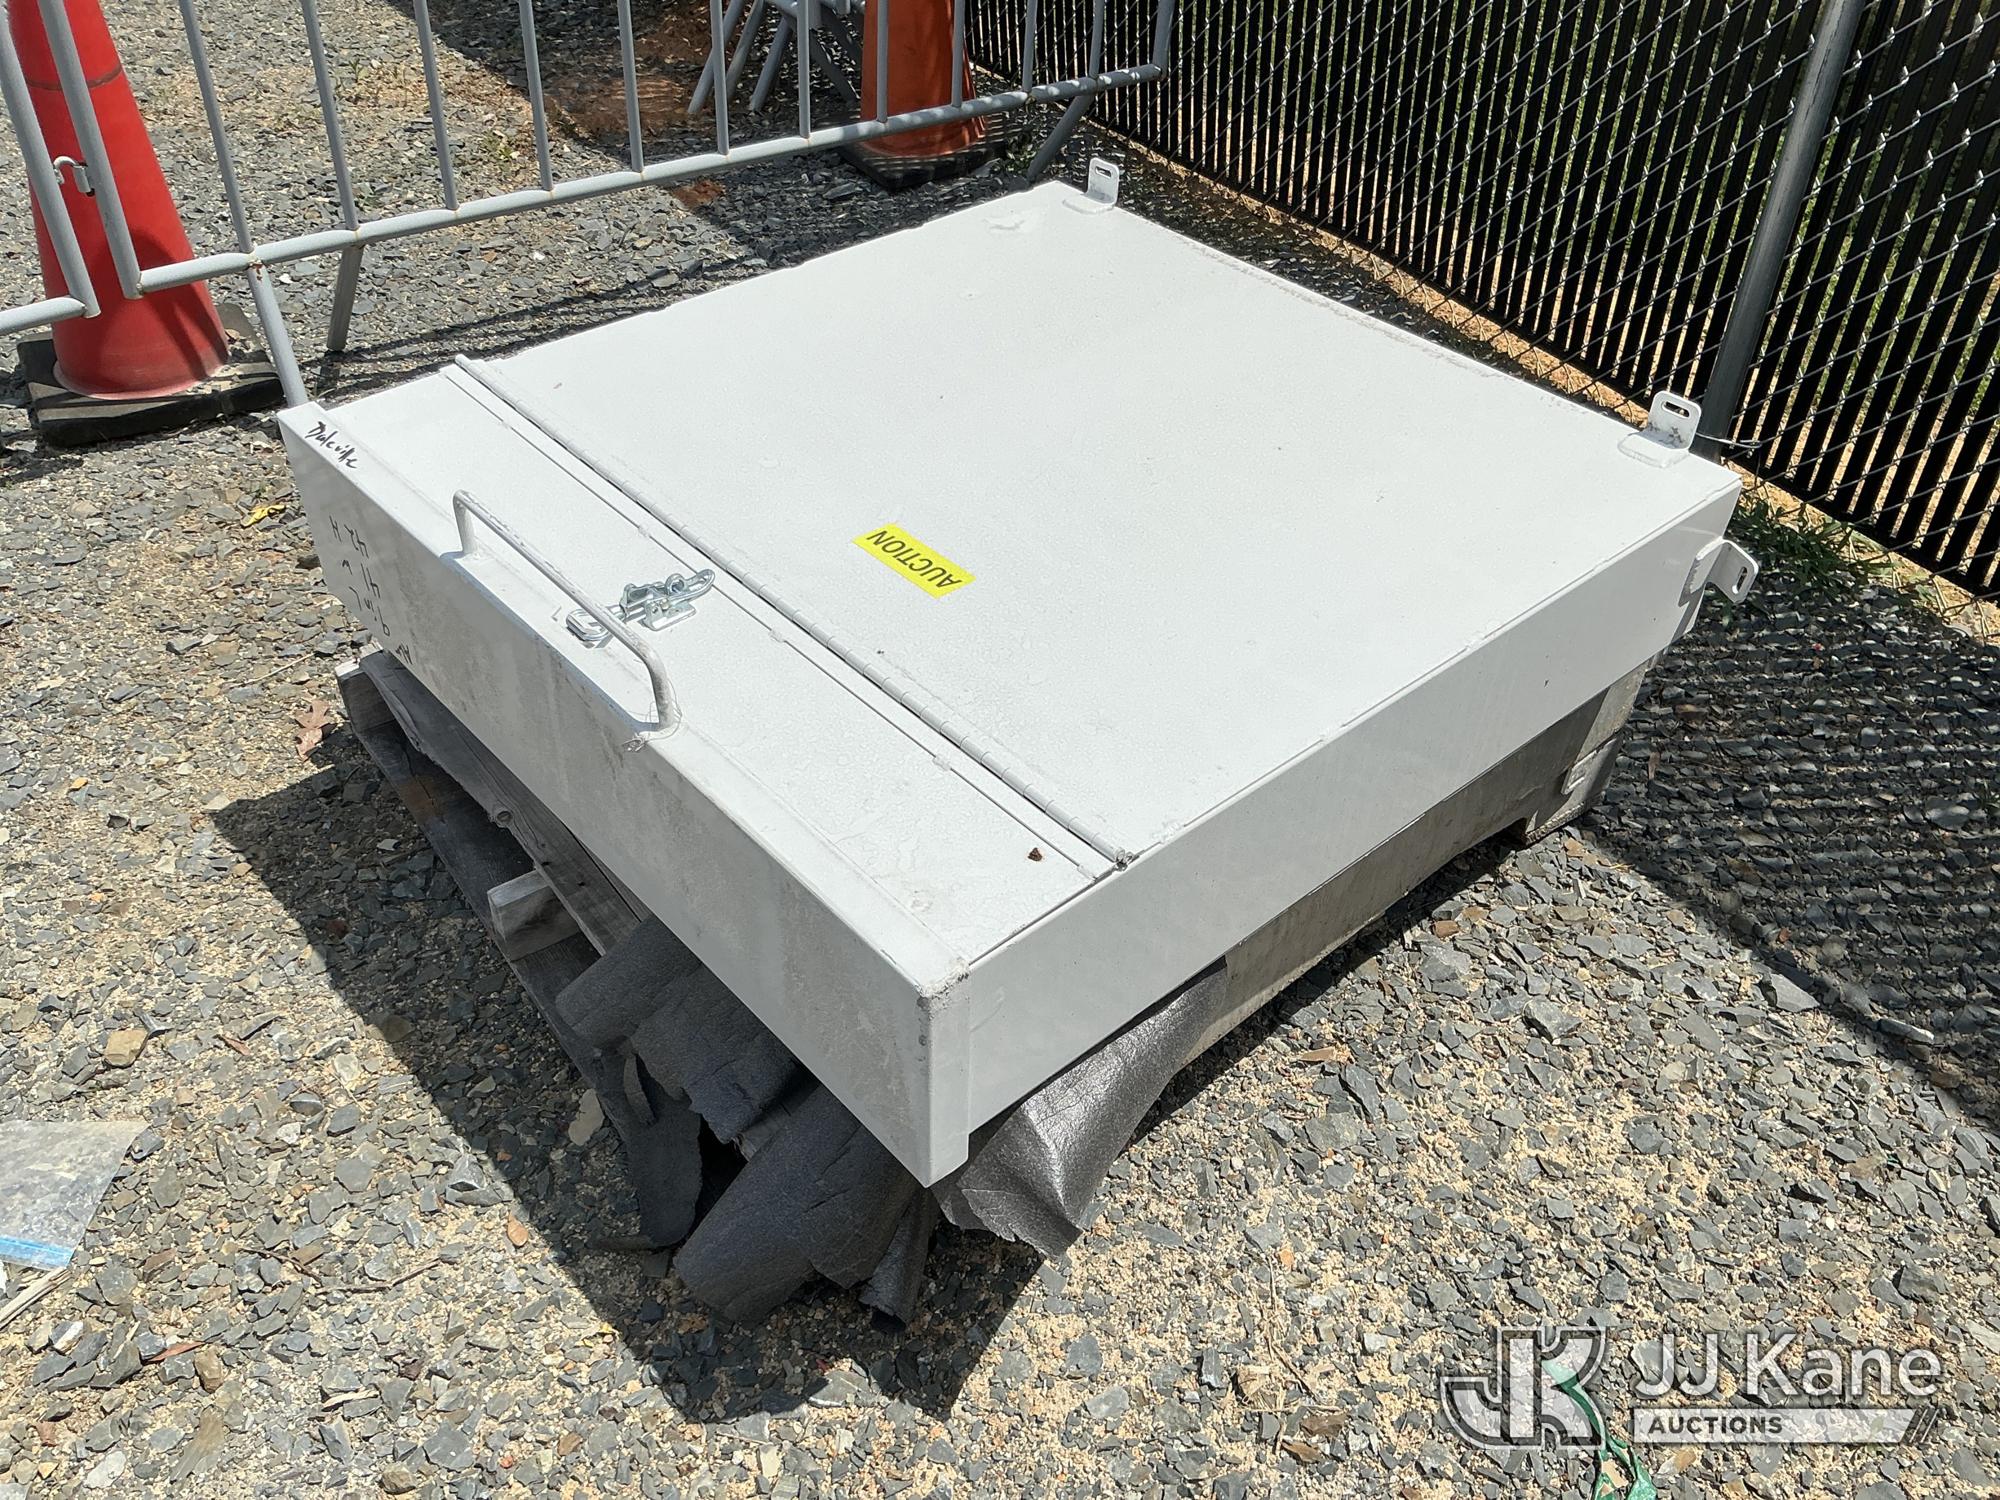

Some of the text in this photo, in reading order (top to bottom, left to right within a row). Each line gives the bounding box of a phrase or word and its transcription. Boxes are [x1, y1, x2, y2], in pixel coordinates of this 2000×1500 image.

[329, 515, 370, 559] 42 H
[865, 529, 963, 589] AUCTION
